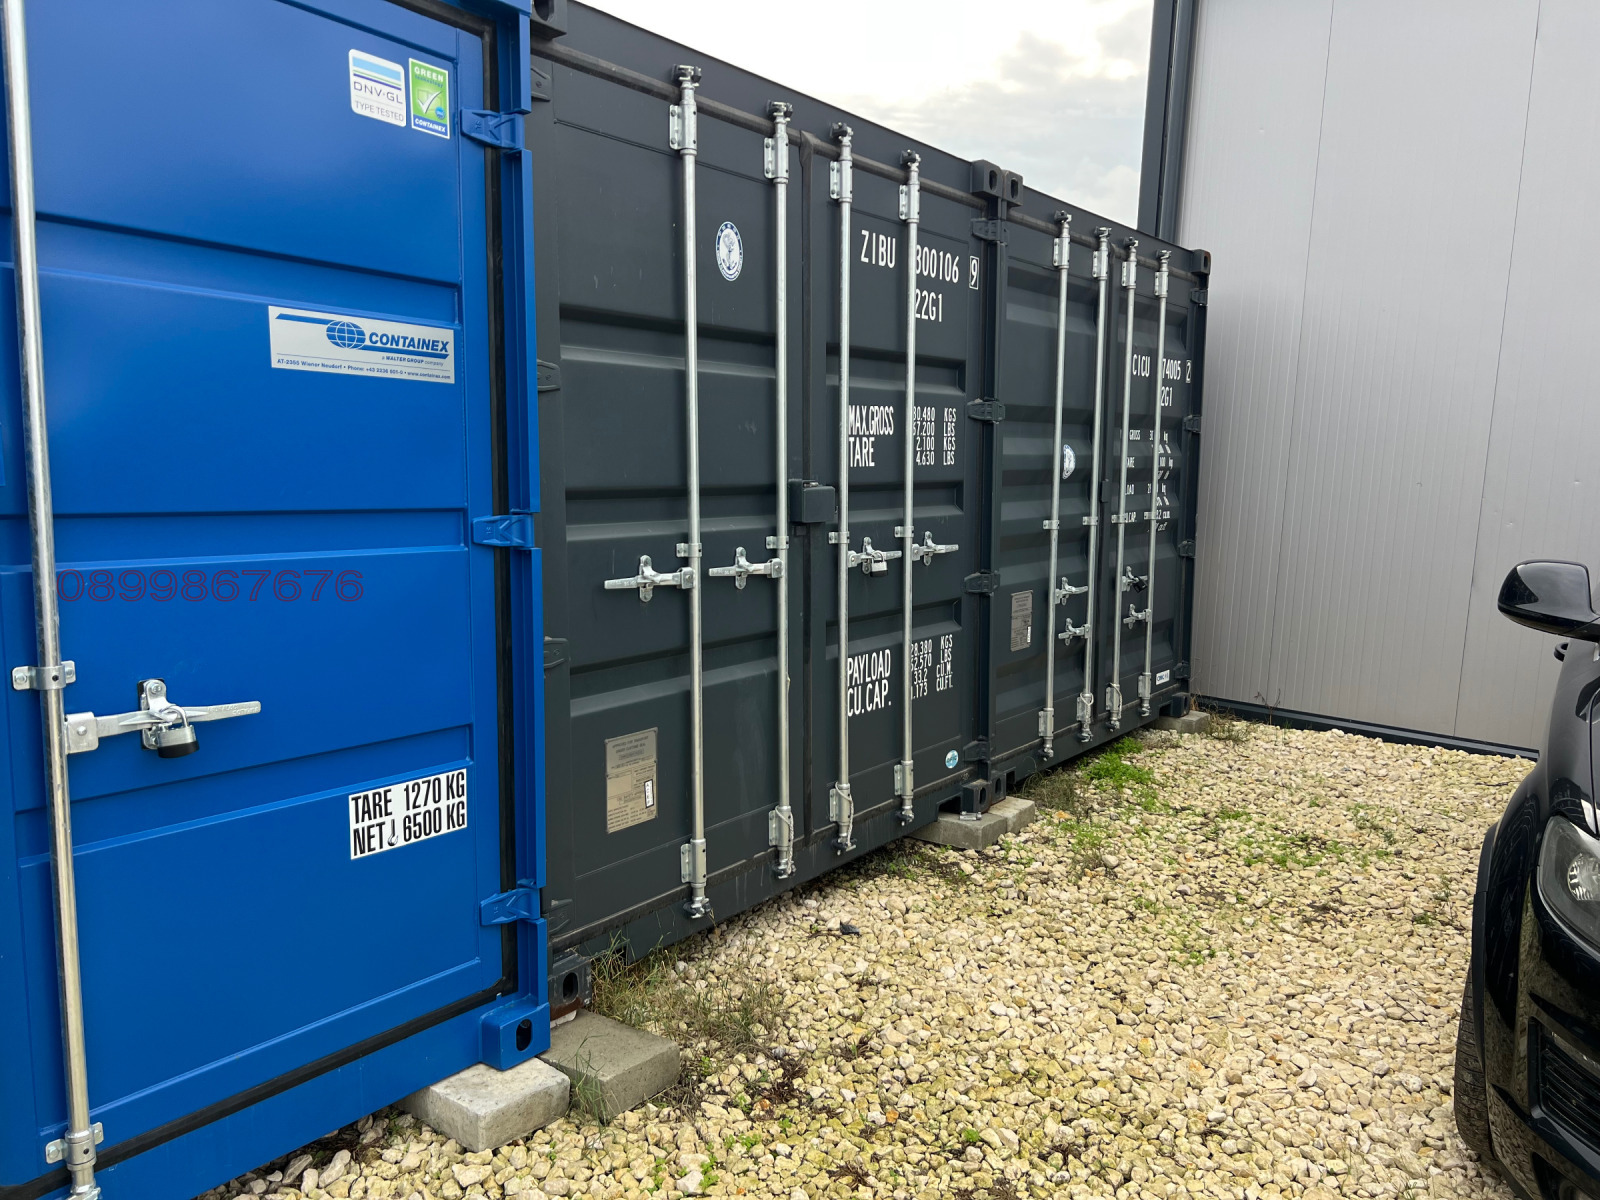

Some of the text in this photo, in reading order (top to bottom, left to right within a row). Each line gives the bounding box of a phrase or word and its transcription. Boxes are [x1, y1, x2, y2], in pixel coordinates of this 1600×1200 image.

[414, 66, 444, 82] GREEN
[355, 100, 404, 122] TYPE TESTED
[415, 118, 446, 133] CONTAINEX
[860, 229, 896, 269] ZIBU
[971, 258, 978, 287] 9
[915, 288, 943, 322] 22G1
[369, 332, 450, 353] CONTAINEX
[1132, 353, 1150, 377] CICU
[1162, 358, 1181, 380] 74005
[1160, 386, 1173, 407] 2G1
[944, 407, 957, 422] KGS
[943, 422, 956, 437] LBS
[848, 436, 956, 467] TARE 2.100 KGS
[915, 451, 955, 466] 4.630 LBS
[847, 649, 891, 687] PAYLOAD
[940, 634, 953, 650] KGS
[940, 648, 952, 664] LBS
[913, 668, 928, 685] 33.2
[351, 771, 465, 825] TARE 1270 KG
[353, 801, 466, 857] NET 6500 KG
